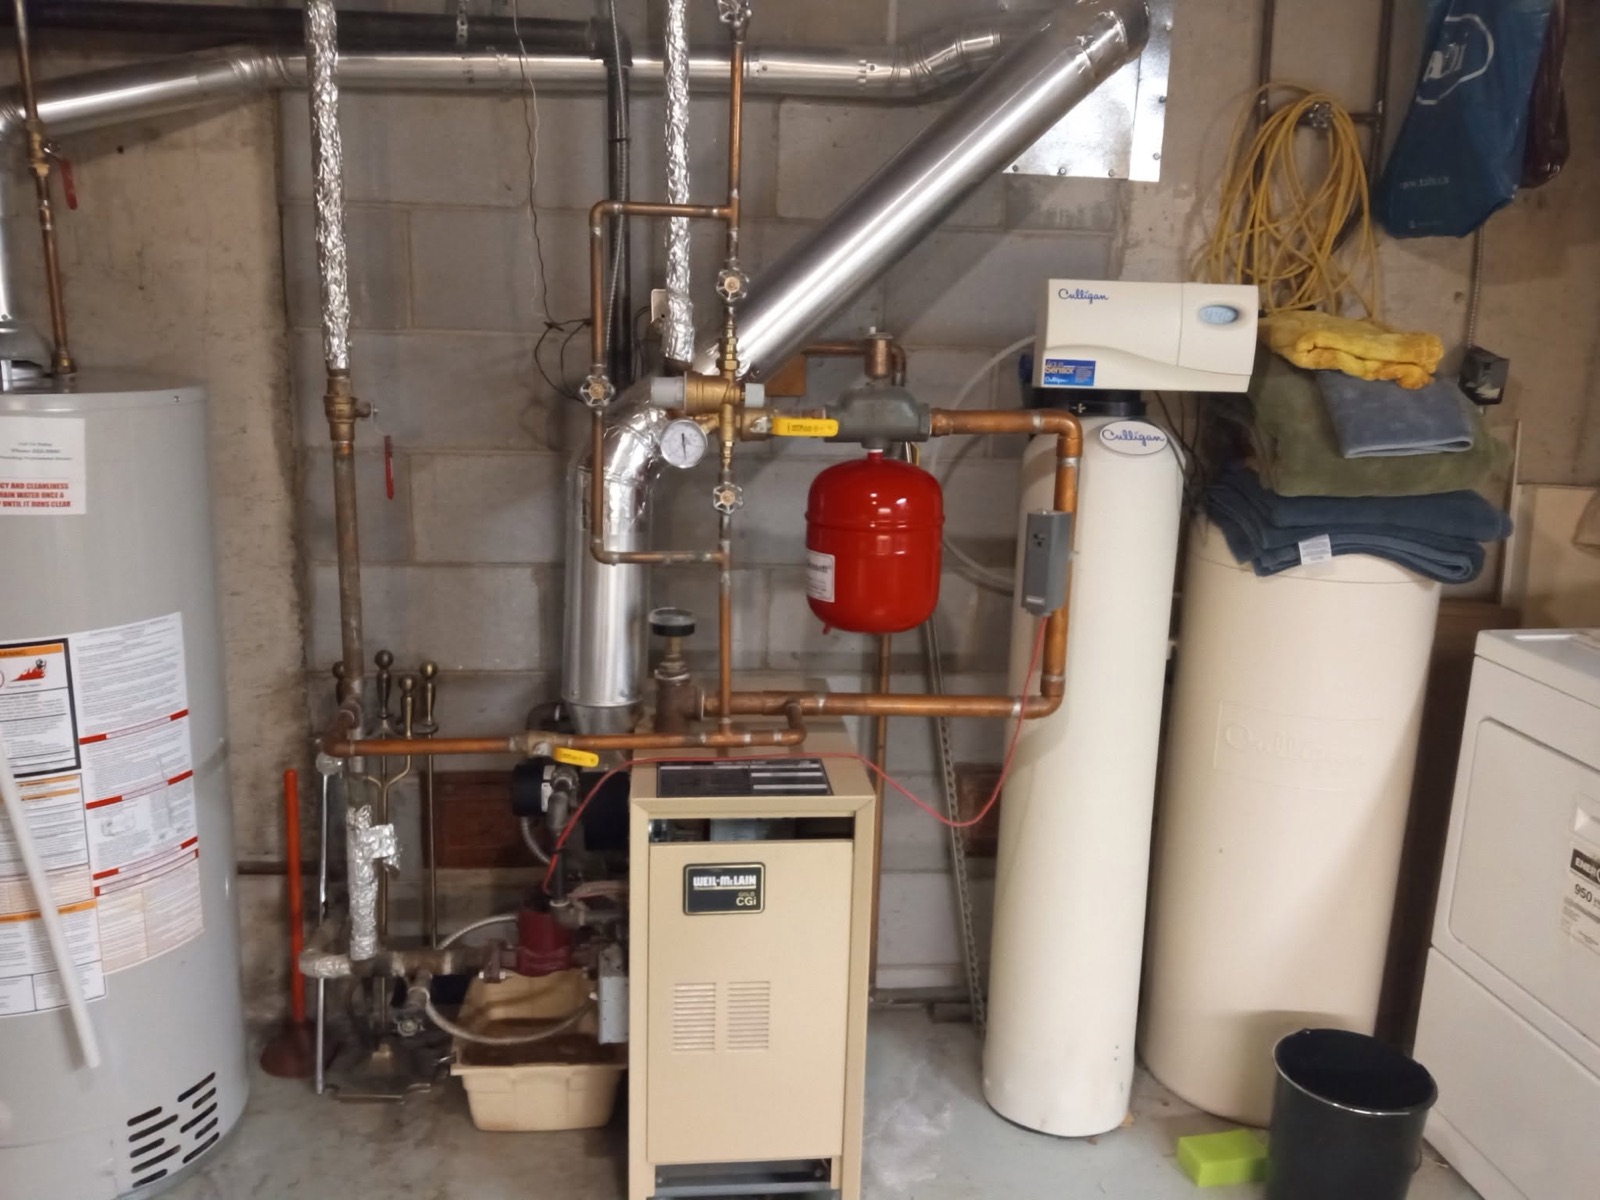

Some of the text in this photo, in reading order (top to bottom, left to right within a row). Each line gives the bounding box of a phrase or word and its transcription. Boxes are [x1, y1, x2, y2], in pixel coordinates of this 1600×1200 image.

[1058, 288, 1109, 304] Culligan
[1045, 365, 1075, 374] Sensor
[1101, 428, 1165, 447] Culligan
[736, 896, 757, 906] CGi
[1574, 883, 1593, 903] 950
